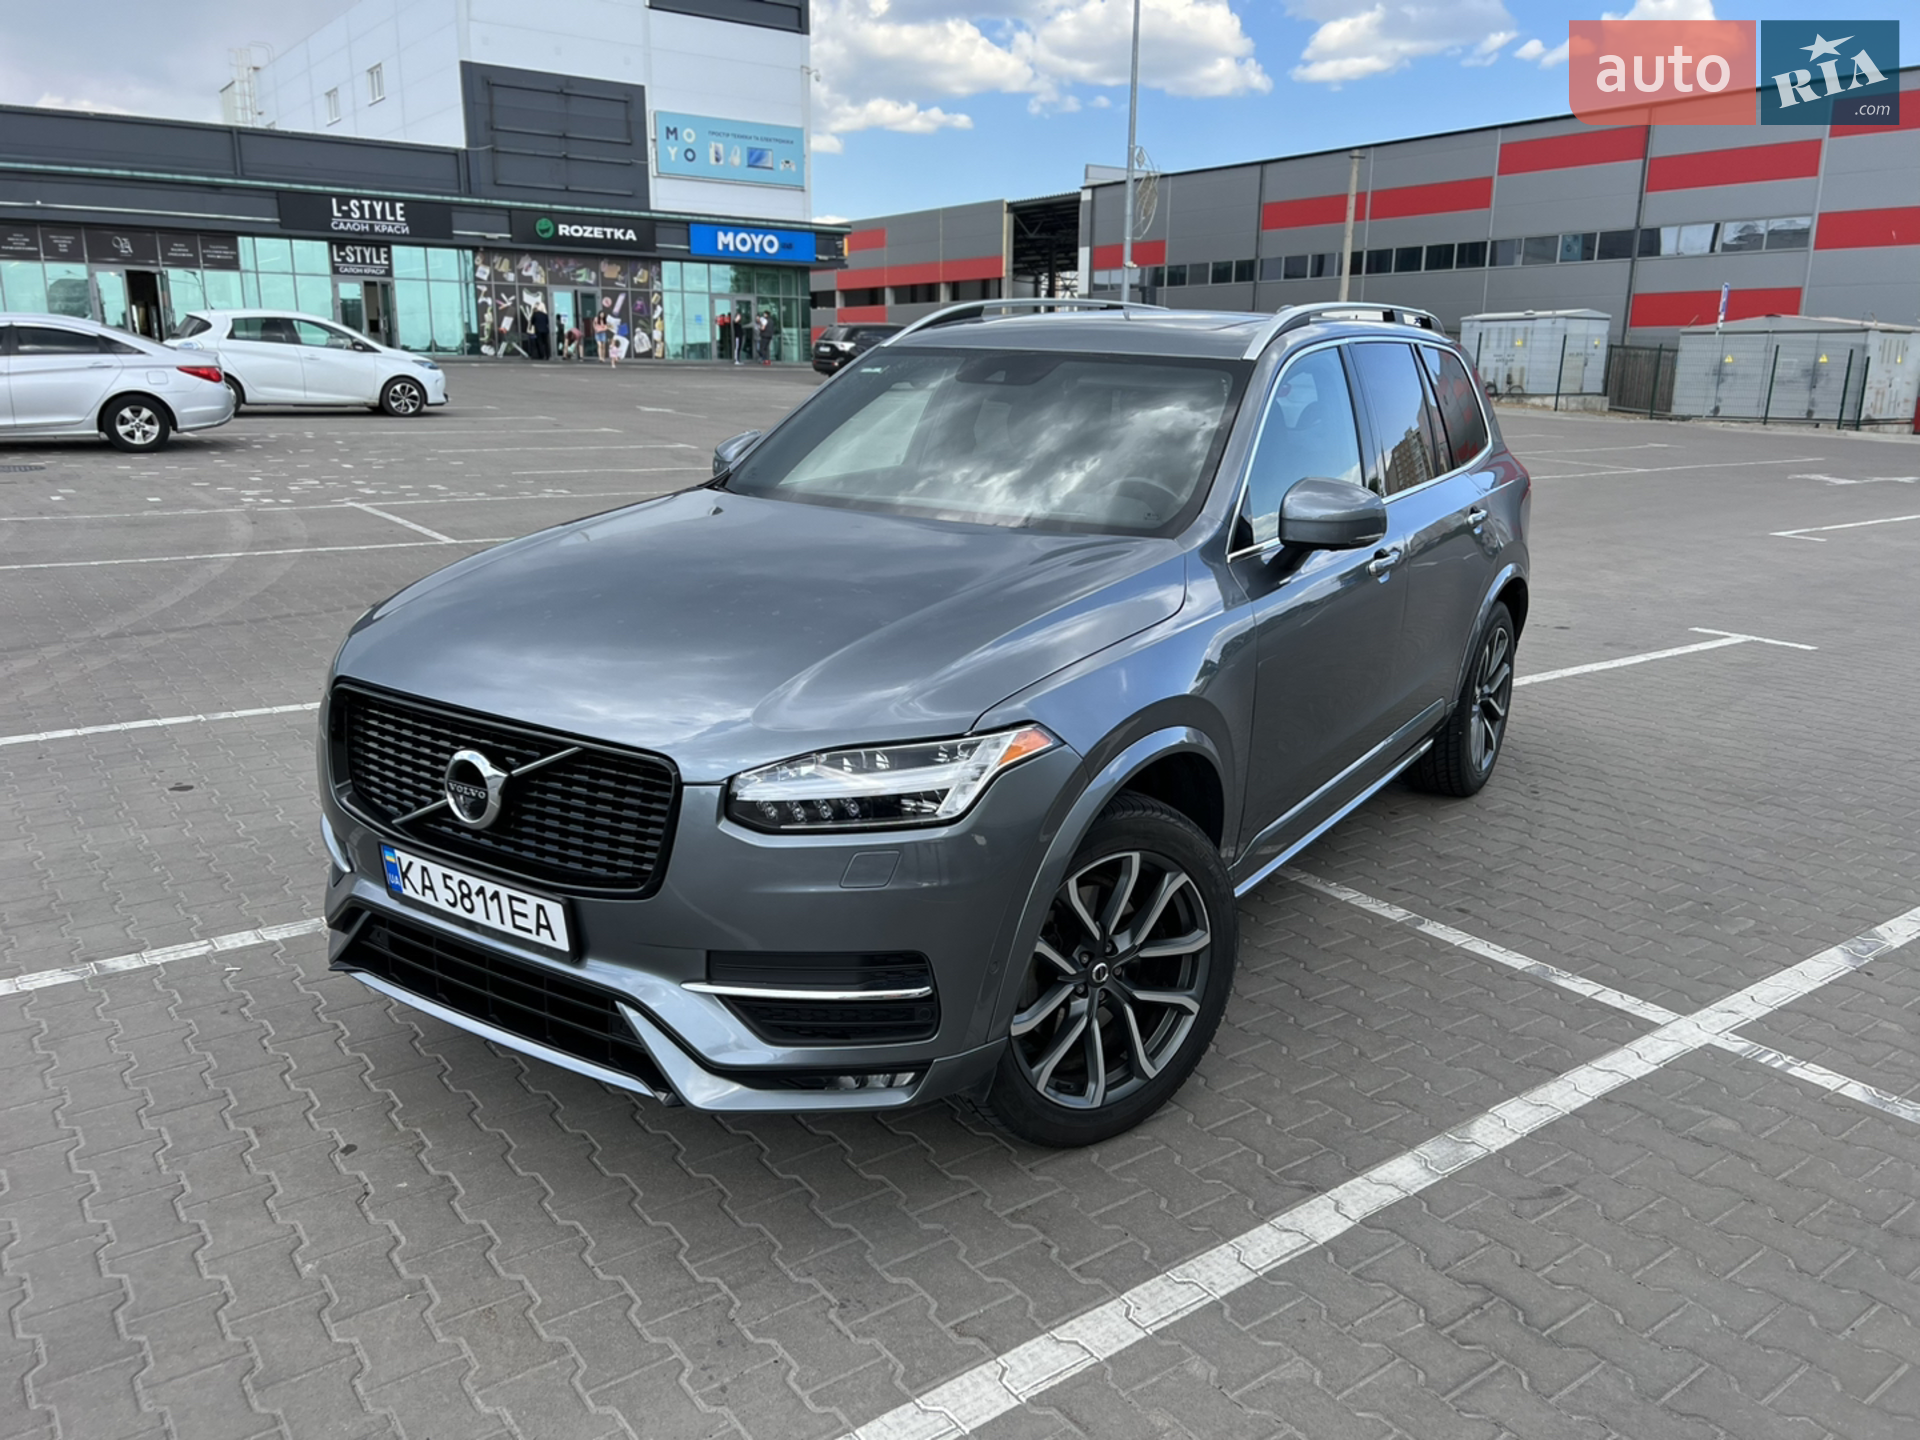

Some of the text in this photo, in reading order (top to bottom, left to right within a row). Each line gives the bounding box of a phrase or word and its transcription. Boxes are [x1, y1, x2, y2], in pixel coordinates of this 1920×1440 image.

[332, 198, 406, 221] L-STYLE
[331, 221, 409, 234] САЛОН КРАСИ
[558, 224, 637, 241] ROZETKA
[717, 231, 779, 254] MOYO
[332, 245, 389, 265] L-STYLE
[448, 782, 486, 799] VOLVO
